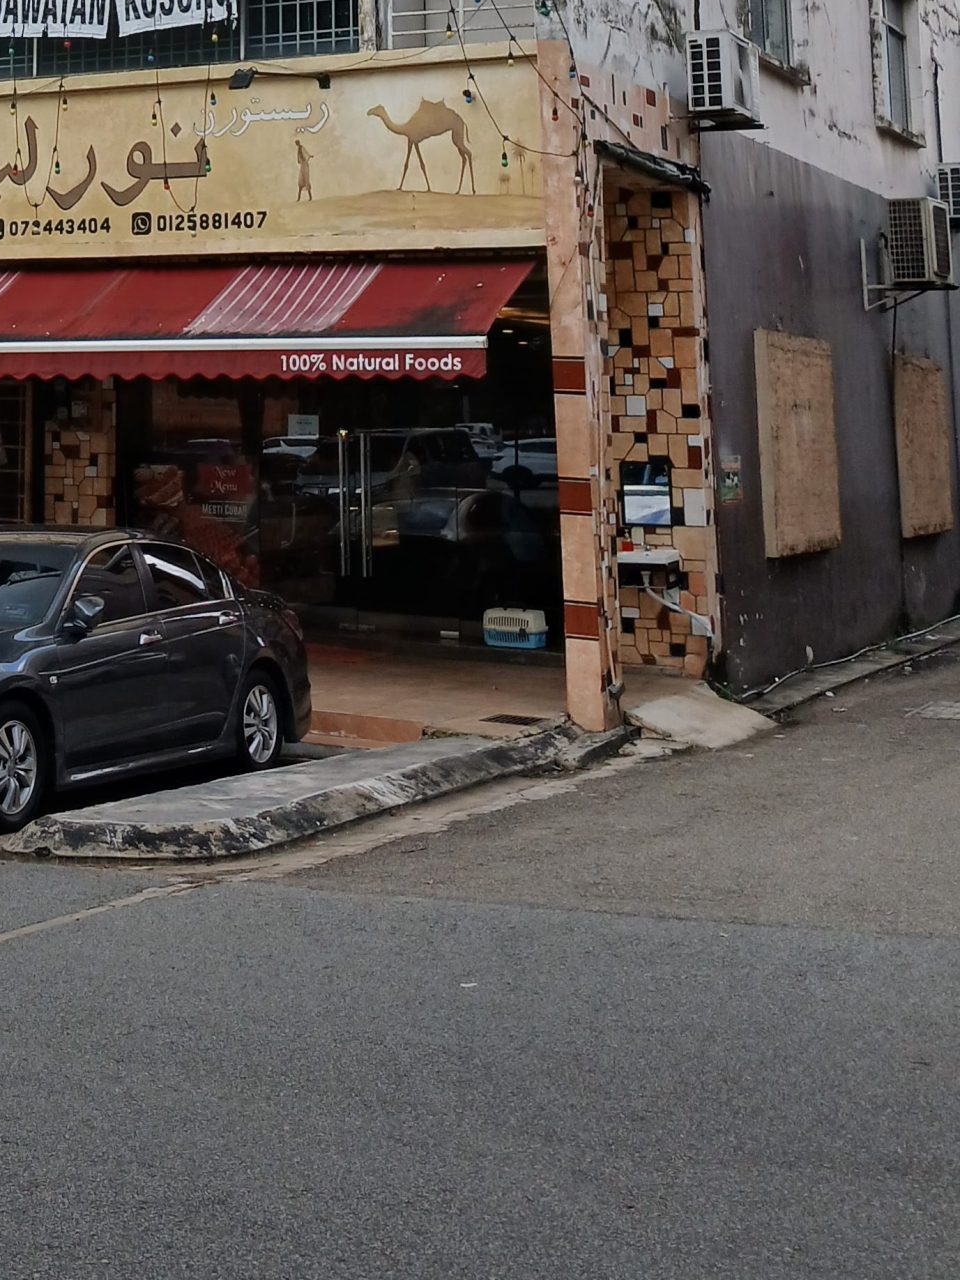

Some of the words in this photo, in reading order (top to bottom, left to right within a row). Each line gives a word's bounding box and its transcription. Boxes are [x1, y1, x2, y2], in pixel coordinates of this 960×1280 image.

[157, 211, 268, 232] 0125881407
[280, 353, 327, 371] 100%
[332, 353, 399, 370] Natural
[405, 352, 462, 370] Foods
